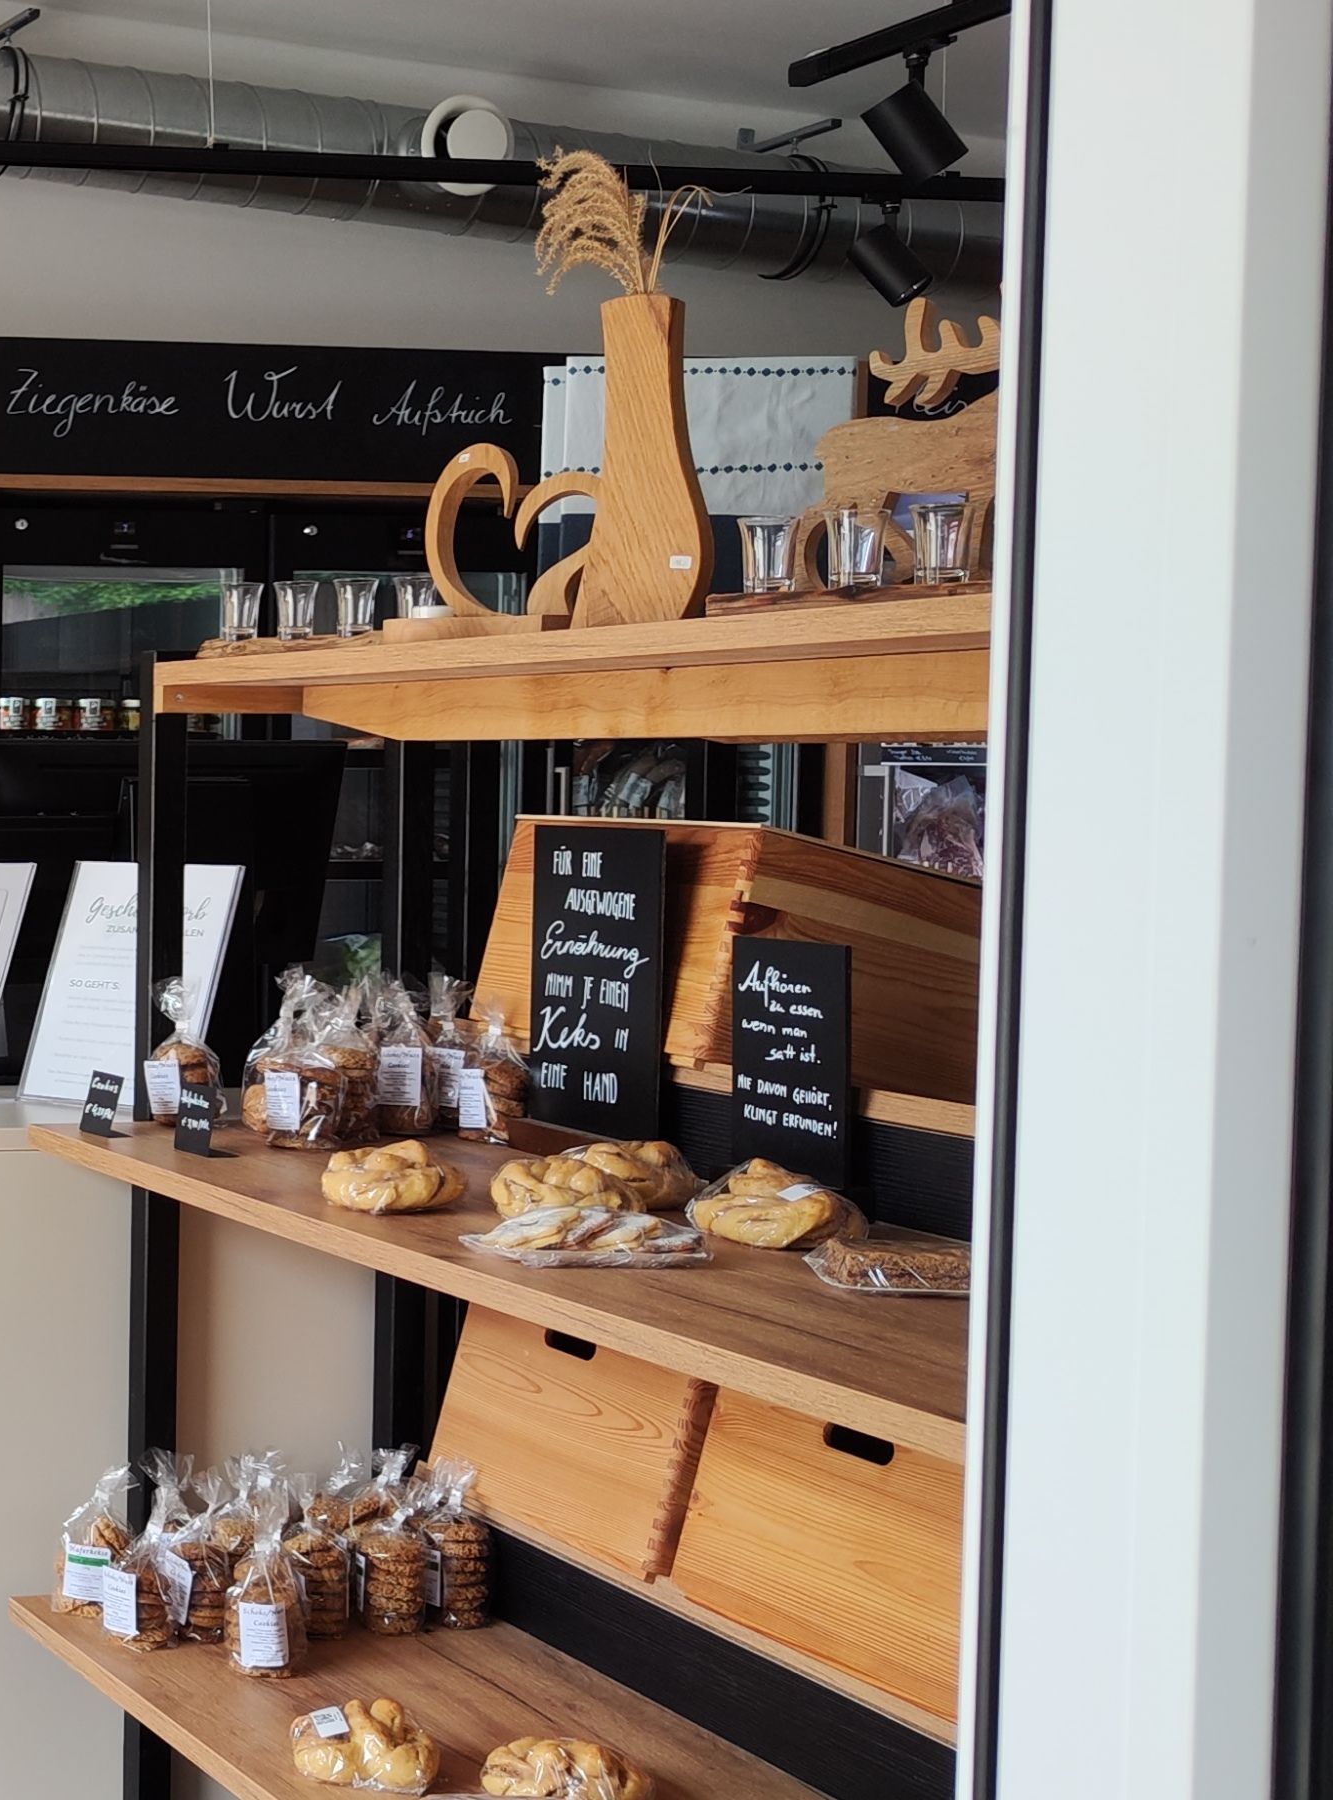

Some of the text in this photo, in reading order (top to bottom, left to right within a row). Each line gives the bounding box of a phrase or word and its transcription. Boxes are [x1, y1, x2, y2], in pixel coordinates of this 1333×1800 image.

[7, 366, 513, 438] Ziegenkäse Wurst Aufstrich
[552, 845, 604, 879] FÜR EINE
[563, 887, 636, 921] AUSGEWOGENE
[540, 920, 650, 979] Ernährung
[545, 972, 630, 1012] NIMM JE EINEN
[738, 960, 813, 1009] Aufhören
[533, 1006, 629, 1052] Keks IN
[741, 1018, 808, 1040] wenn man
[769, 999, 824, 1020] zu essen
[764, 1044, 822, 1065] satt ist.
[541, 1062, 618, 1105] EINE HAND
[737, 1073, 833, 1113] NIE DAVON GEHÖRT,
[743, 1103, 838, 1140] KLINGT ERFUNDEN!
